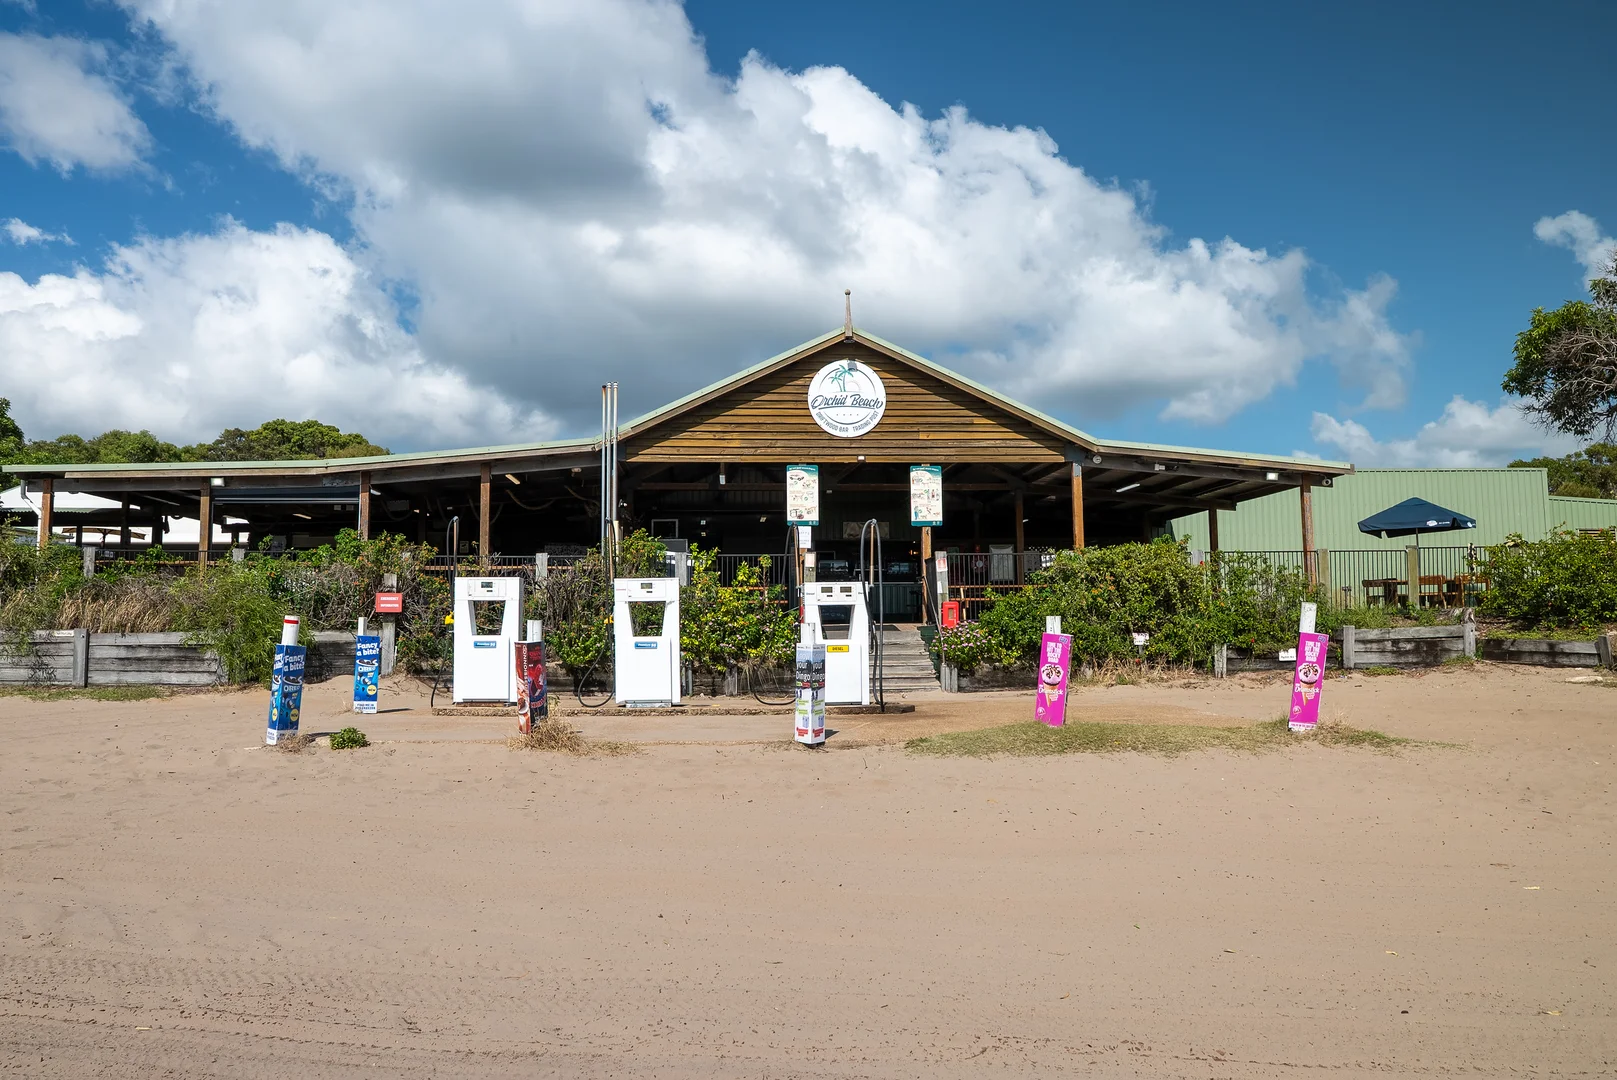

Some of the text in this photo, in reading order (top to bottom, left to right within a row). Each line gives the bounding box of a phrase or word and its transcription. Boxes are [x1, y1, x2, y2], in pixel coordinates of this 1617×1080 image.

[811, 394, 884, 410] Orchid Beach
[816, 411, 838, 431] DRIFTWOOD
[852, 410, 880, 433] TRADING POST
[357, 642, 378, 650] Fancy
[363, 648, 379, 656] bite?
[283, 654, 304, 664] Fancy
[289, 661, 305, 671] bite?
[796, 661, 808, 670] your
[812, 662, 823, 671] your
[796, 670, 811, 682] Dingo
